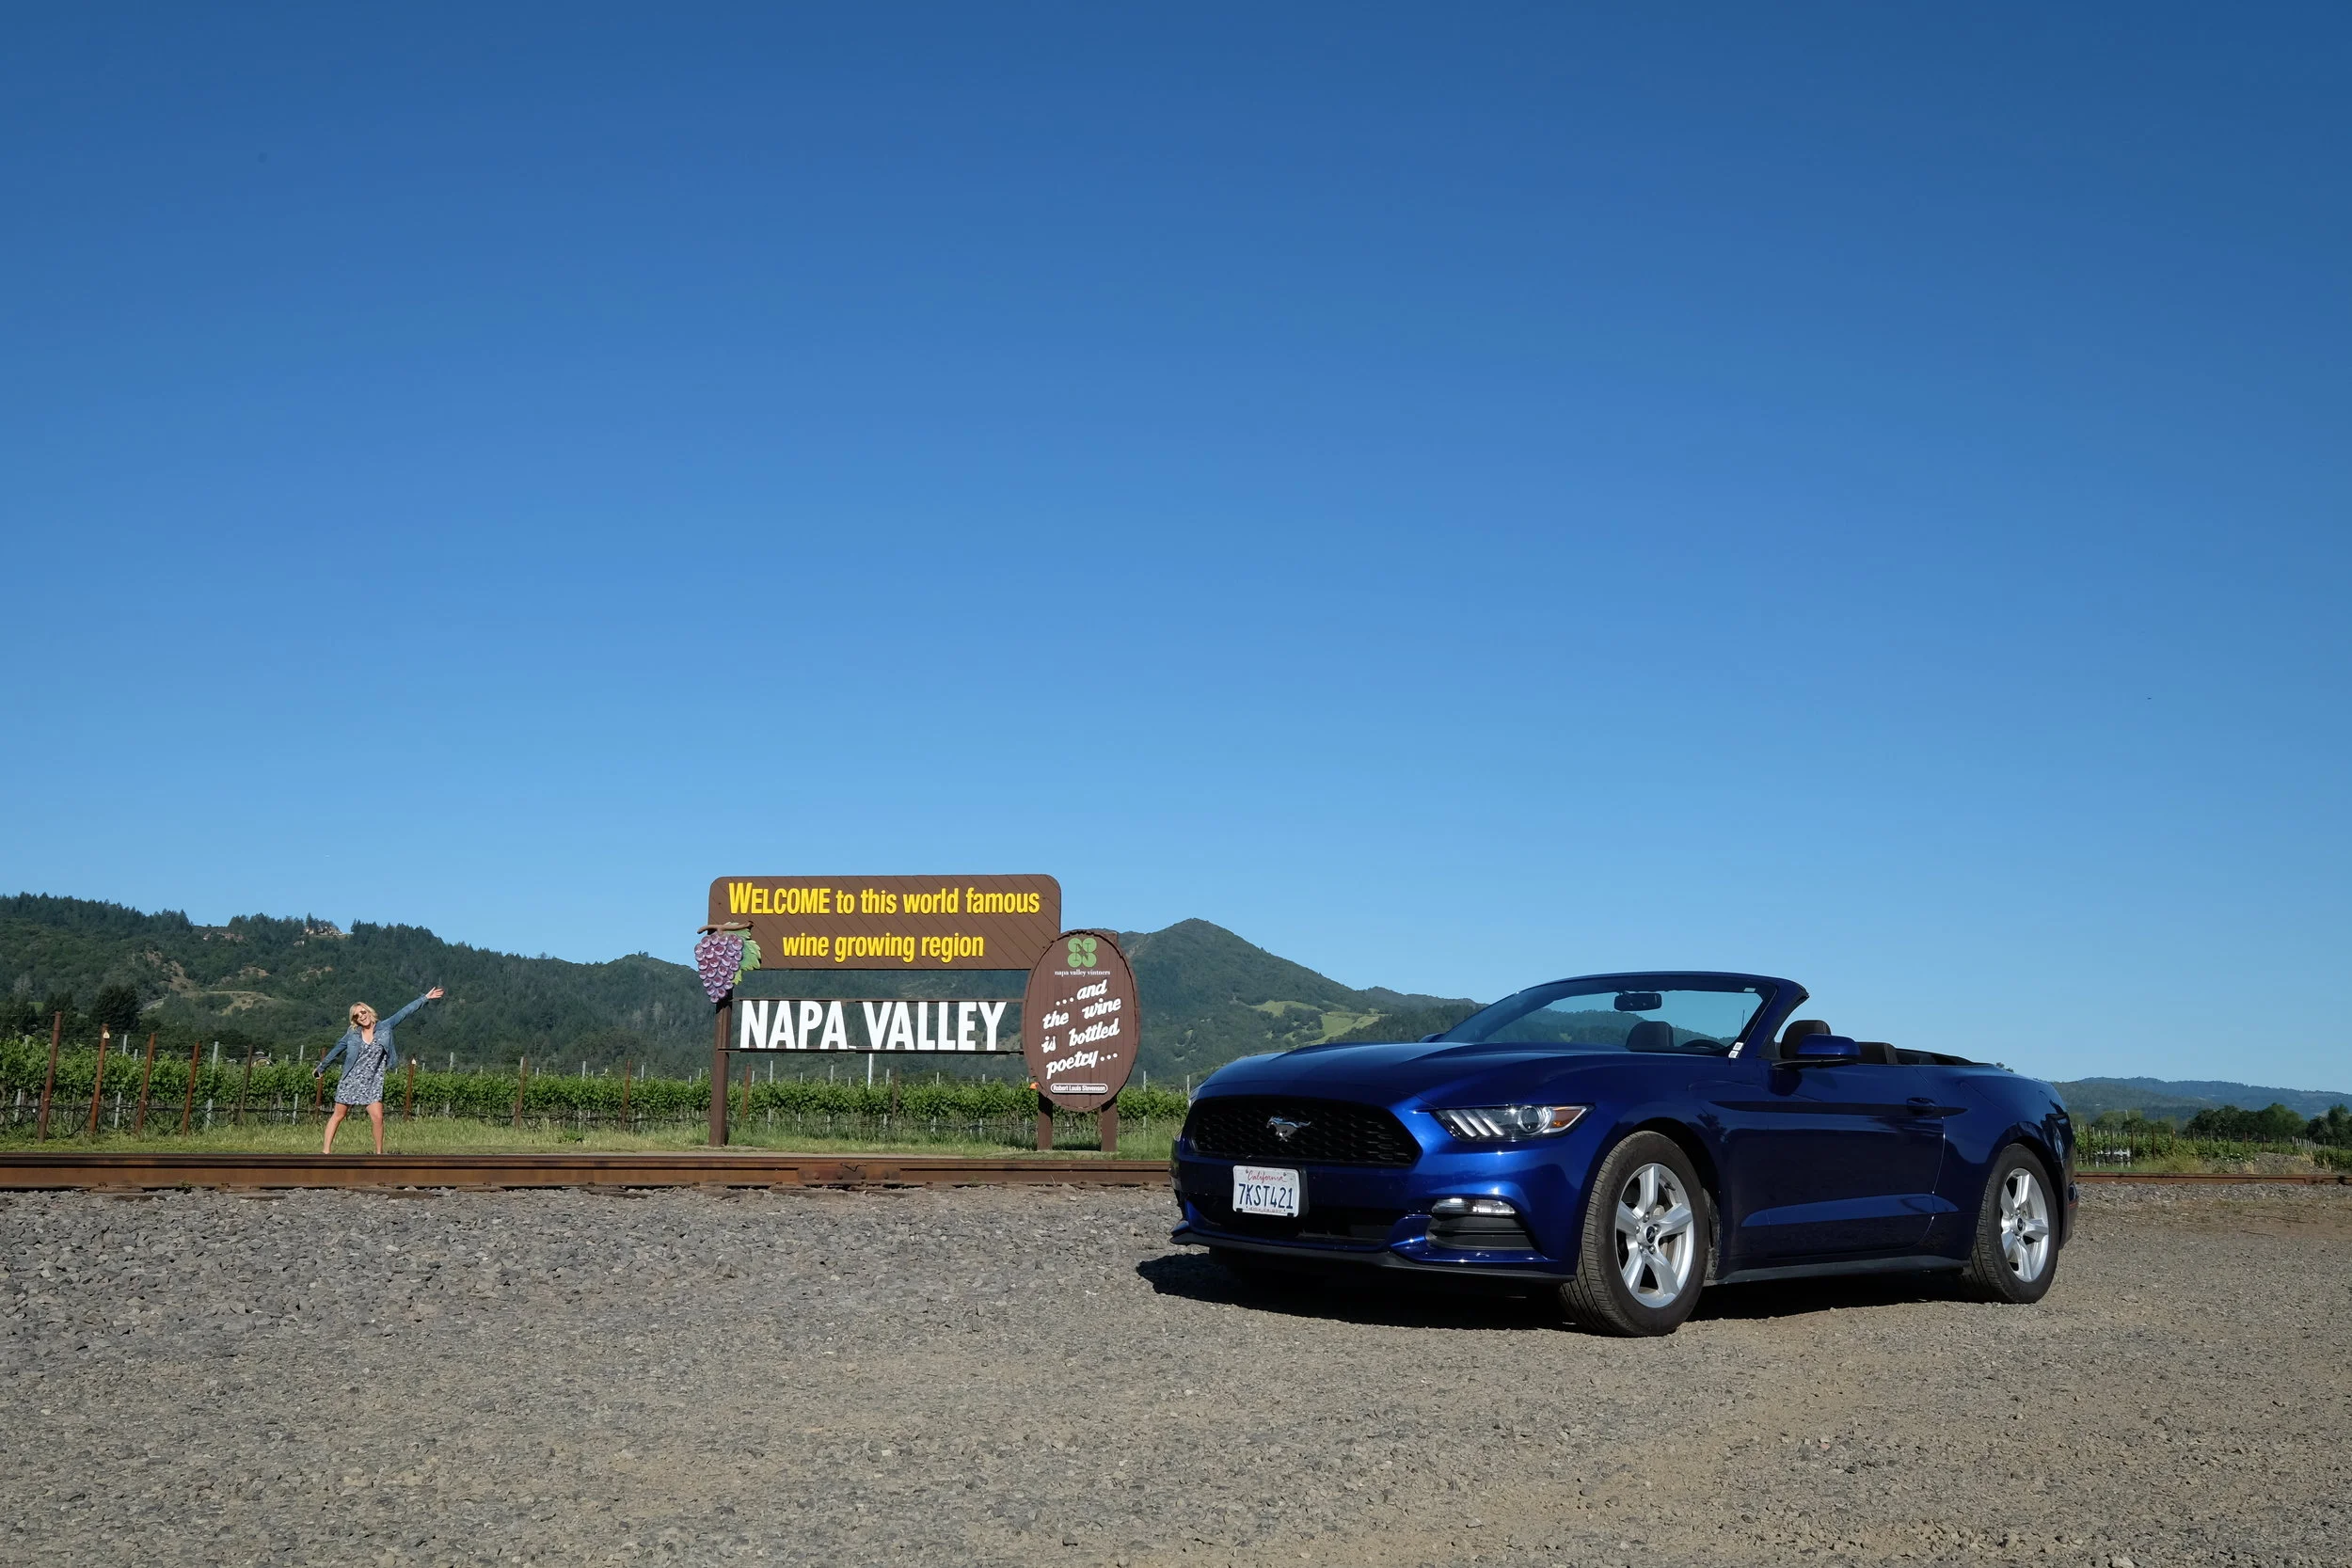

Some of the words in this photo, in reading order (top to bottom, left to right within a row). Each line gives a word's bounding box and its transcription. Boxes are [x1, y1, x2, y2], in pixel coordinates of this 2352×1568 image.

[728, 882, 831, 914] WELCOME
[835, 890, 855, 914] to
[861, 888, 898, 914] this
[903, 887, 960, 914] world
[965, 887, 1041, 914] famous
[783, 932, 829, 957] wine
[834, 932, 915, 963] growing
[921, 932, 984, 963] region
[1070, 969, 1087, 977] valley
[739, 1000, 848, 1050] NAPA
[862, 1001, 1008, 1052] VALLEY
[1042, 1009, 1070, 1030] the
[1081, 997, 1121, 1020] wine
[1041, 1036, 1057, 1053] is
[1068, 1018, 1120, 1047] bottled
[1248, 1170, 1288, 1184] California
[1238, 1182, 1294, 1210] 7KST421
